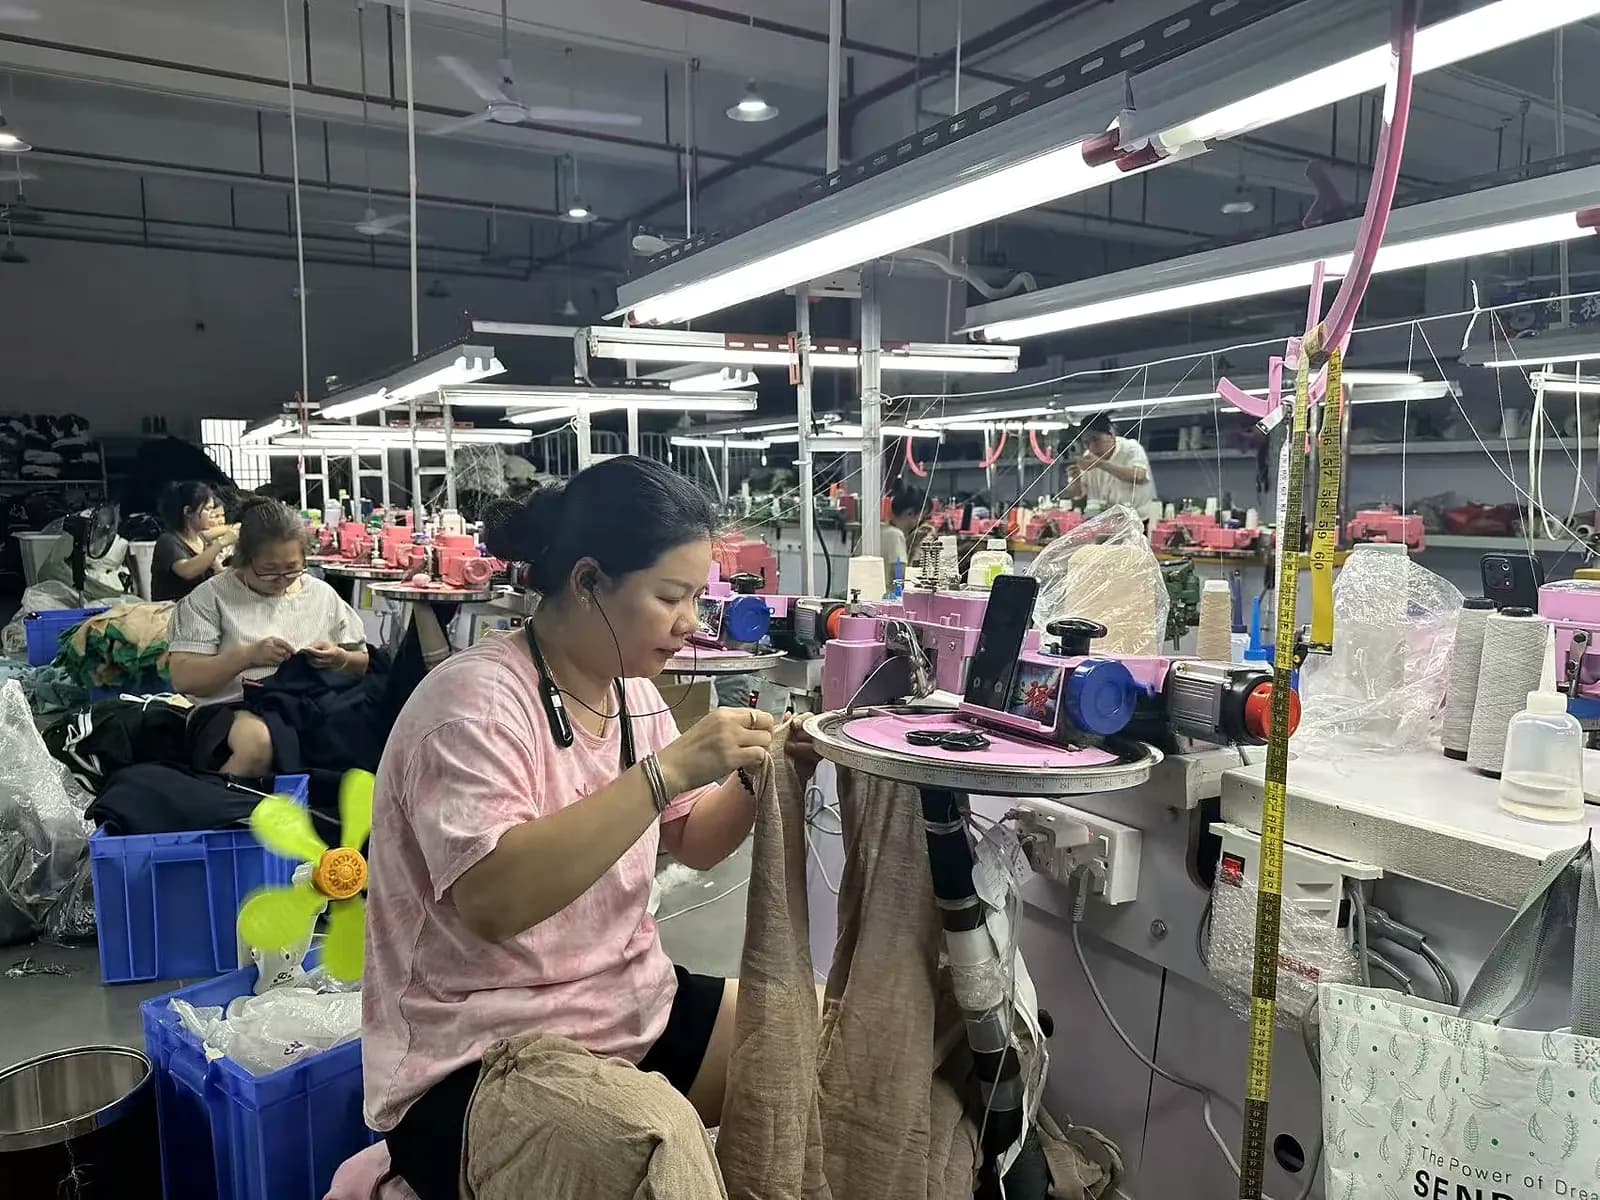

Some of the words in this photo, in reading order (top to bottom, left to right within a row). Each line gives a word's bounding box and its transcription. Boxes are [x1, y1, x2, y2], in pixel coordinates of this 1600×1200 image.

[1323, 458, 1333, 477] 57
[1320, 489, 1331, 508] 58
[1317, 520, 1328, 539] 59
[1314, 551, 1325, 570] 60
[1421, 1146, 1444, 1167] The
[1449, 1157, 1512, 1184] Power
[1524, 1176, 1543, 1190] of
